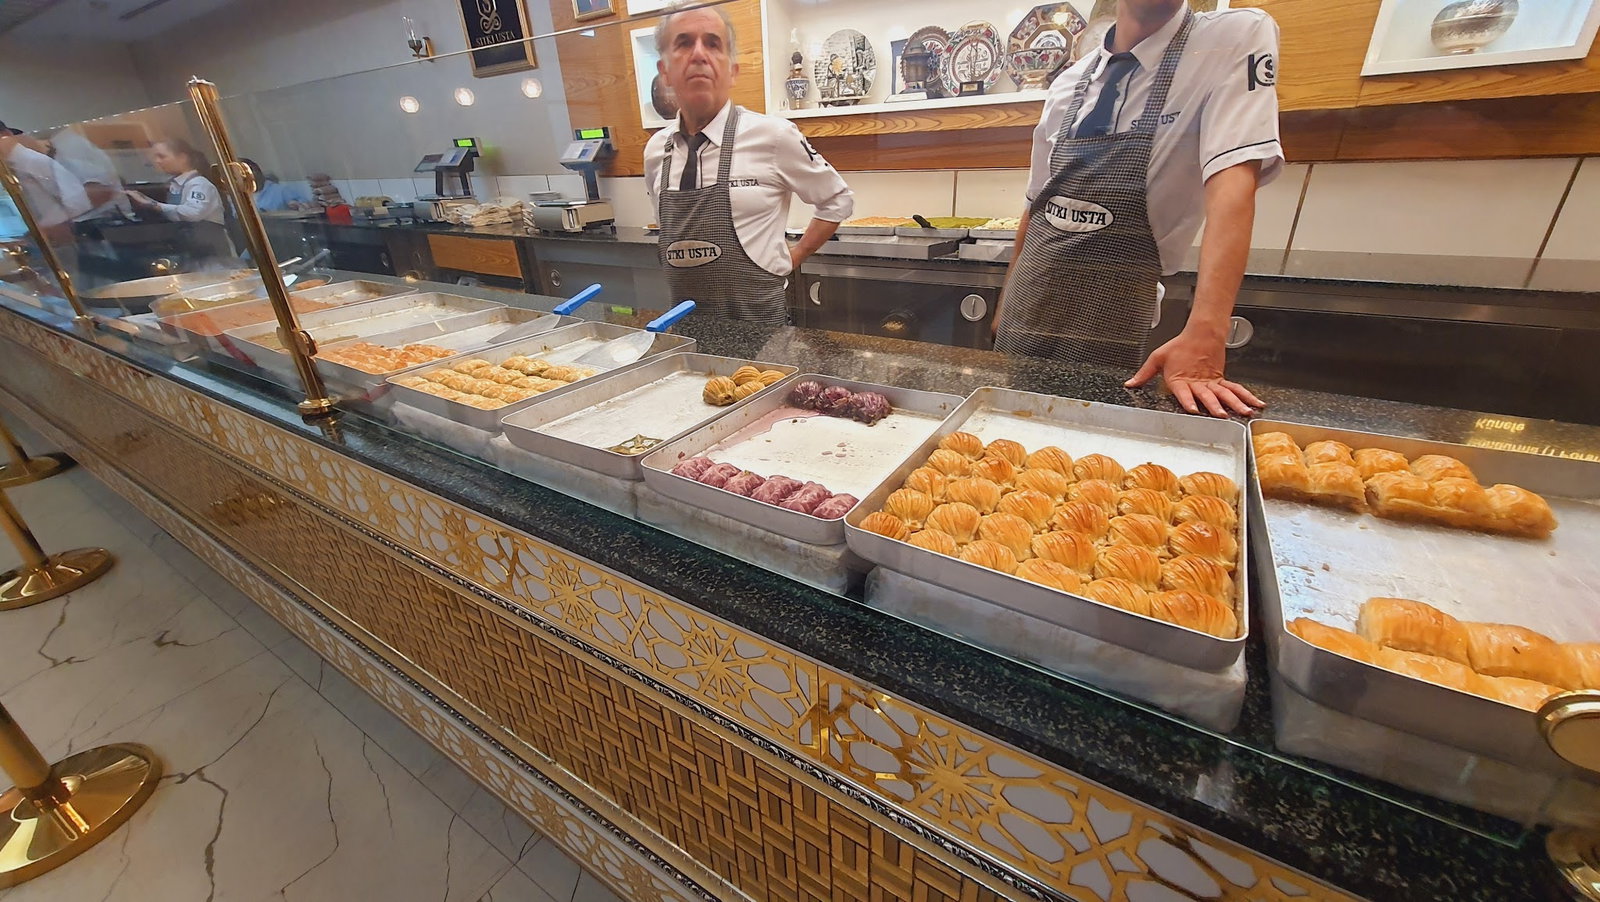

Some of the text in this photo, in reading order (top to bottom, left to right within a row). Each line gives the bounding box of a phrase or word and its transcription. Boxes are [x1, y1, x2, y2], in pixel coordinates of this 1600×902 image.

[495, 31, 516, 41] USTA
[740, 179, 760, 187] USTA
[1072, 209, 1107, 225] USTA
[688, 247, 718, 259] USTA
